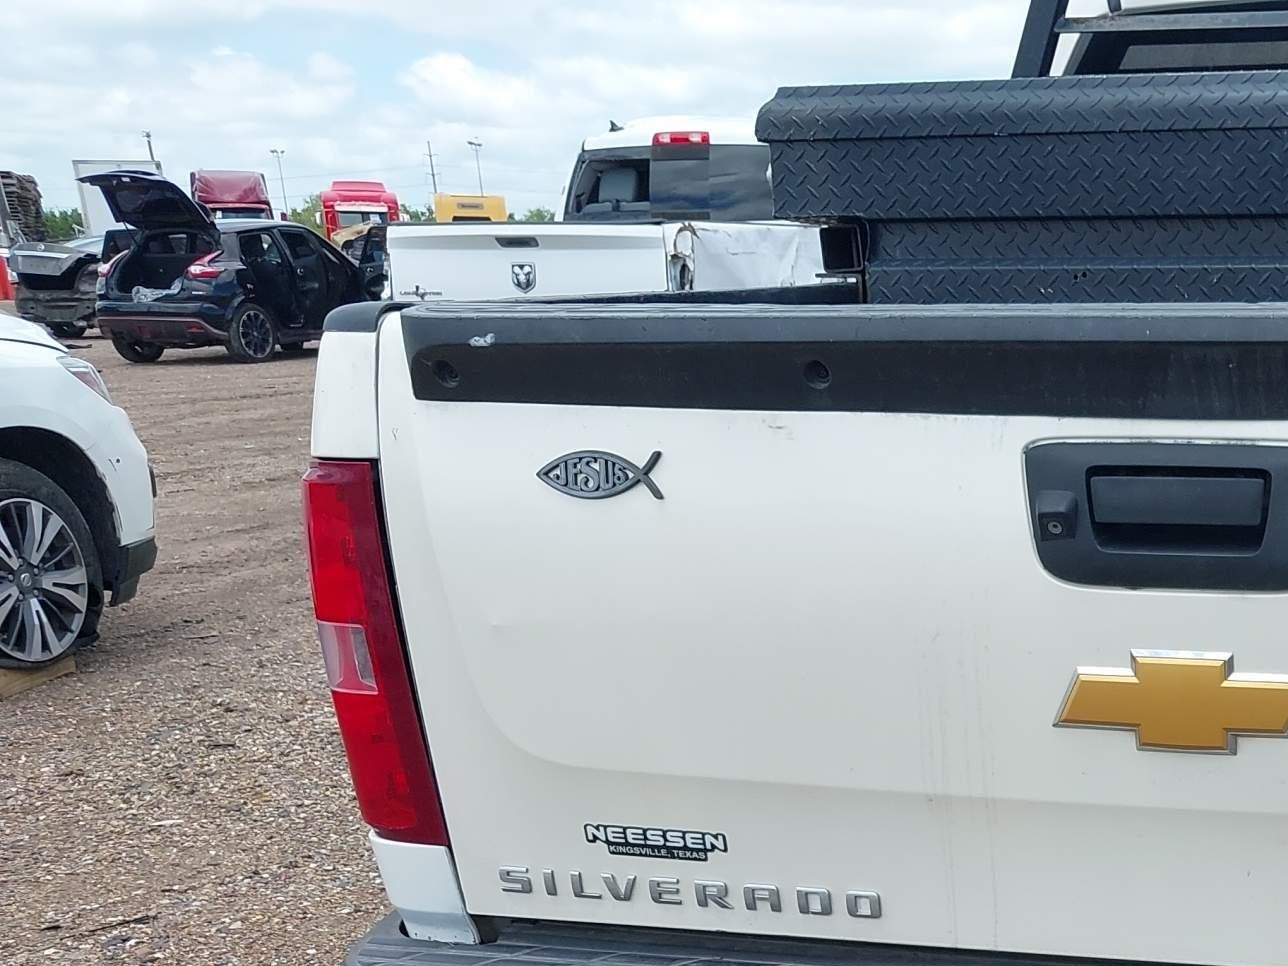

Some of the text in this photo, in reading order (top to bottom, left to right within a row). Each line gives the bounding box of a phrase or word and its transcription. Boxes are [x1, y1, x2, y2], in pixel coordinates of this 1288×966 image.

[552, 456, 630, 492] JESUS
[585, 824, 726, 851] NEESSEN
[609, 844, 706, 859] KINGSVILLE, TEXAS
[499, 864, 883, 919] SILVERADO
